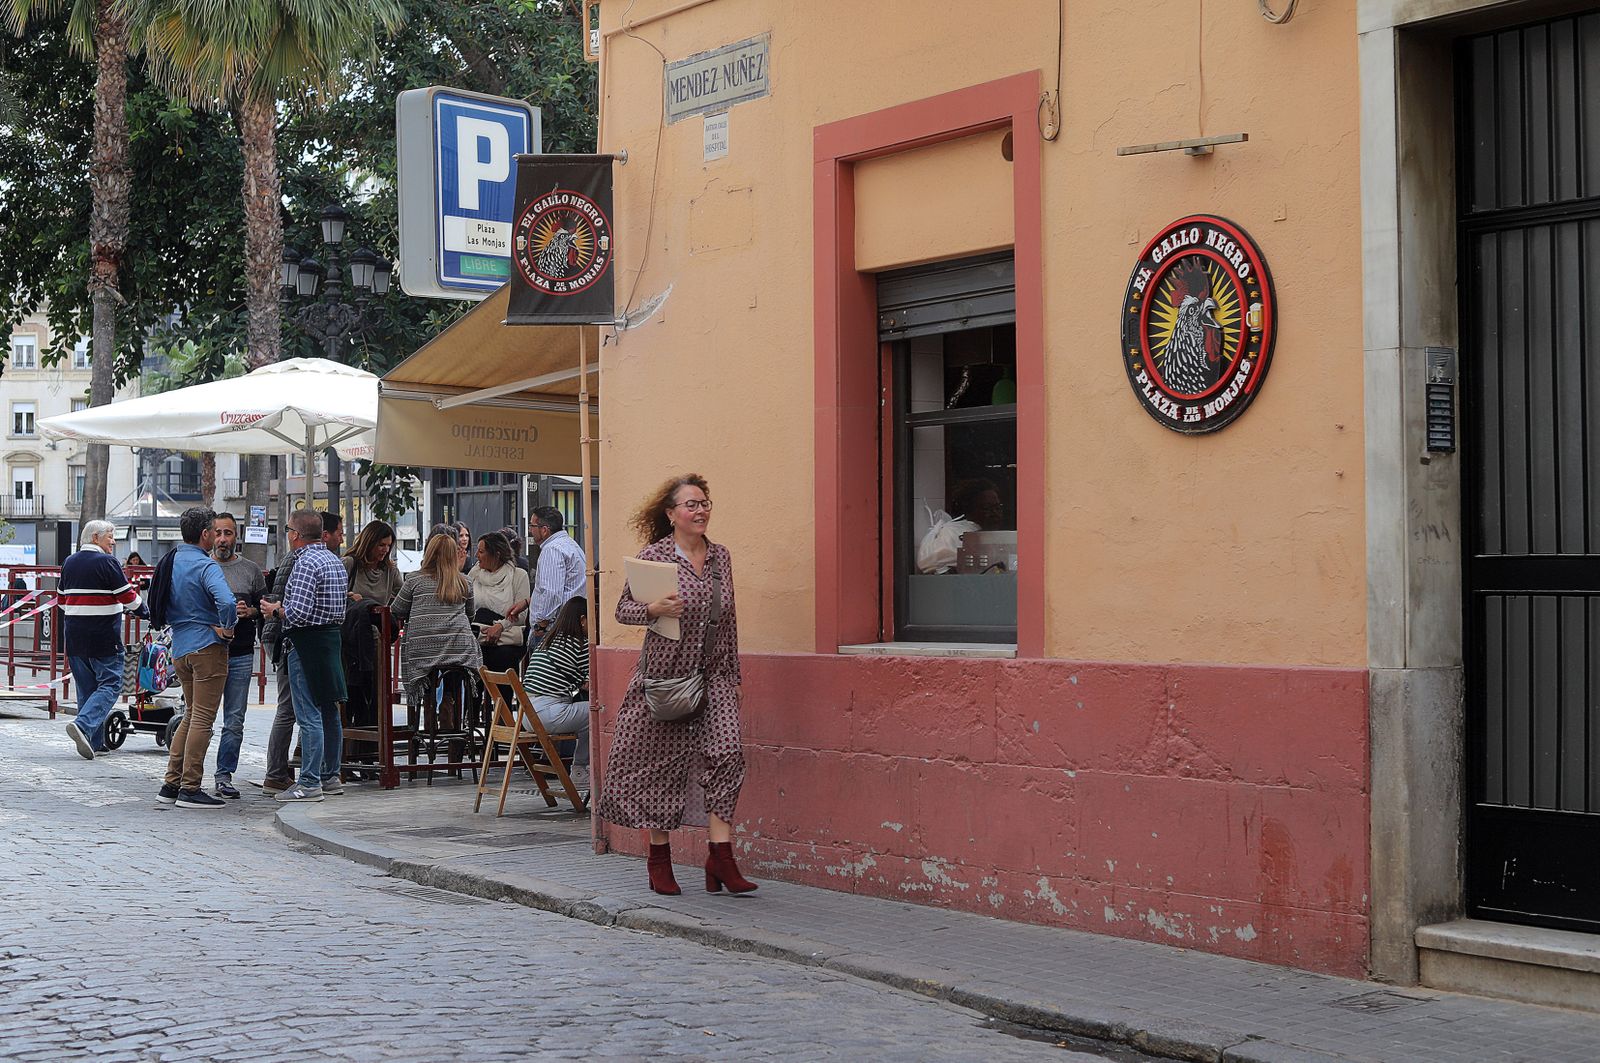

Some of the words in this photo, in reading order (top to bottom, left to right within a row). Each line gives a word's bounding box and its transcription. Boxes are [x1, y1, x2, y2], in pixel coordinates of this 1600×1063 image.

[670, 67, 718, 105] MENDEZ
[723, 53, 764, 90] NUÑEZ
[456, 115, 510, 211] P
[520, 213, 536, 228] EL
[533, 194, 569, 213] GALLO
[569, 195, 604, 227] NEGRO
[467, 236, 479, 245] Las
[482, 237, 506, 248] Monjas
[477, 223, 496, 234] Plaza
[463, 258, 497, 272] LIBRE
[520, 257, 550, 290] PLAZA
[568, 256, 604, 290] MONJAS
[1133, 267, 1152, 293] EL
[1151, 227, 1200, 264] GALLO
[1205, 229, 1250, 279] NEGRO
[1136, 369, 1179, 420] PLAZA
[1203, 358, 1251, 418] MONJAS
[1183, 414, 1201, 423] LAS
[1185, 406, 1199, 415] DE
